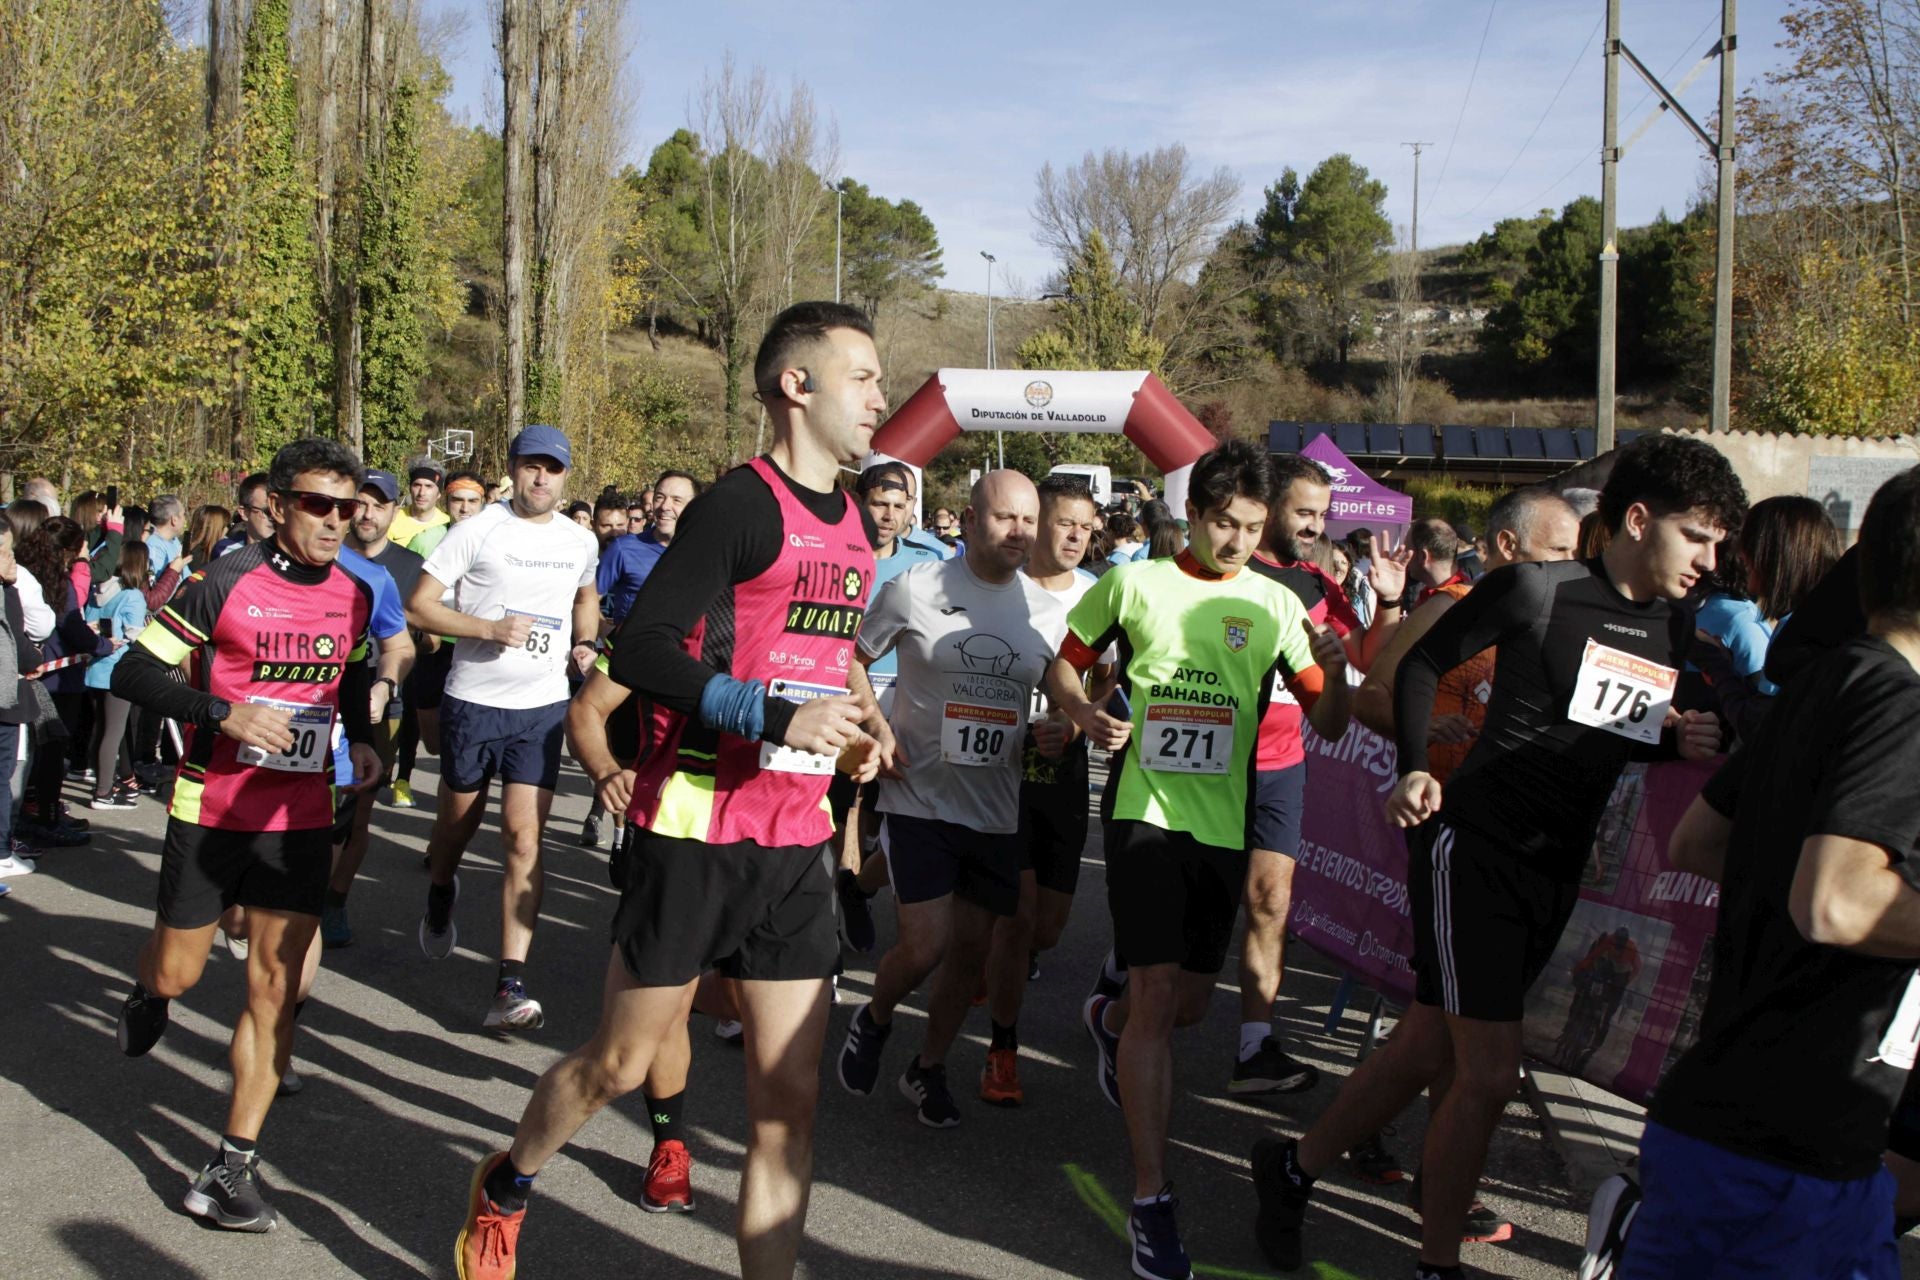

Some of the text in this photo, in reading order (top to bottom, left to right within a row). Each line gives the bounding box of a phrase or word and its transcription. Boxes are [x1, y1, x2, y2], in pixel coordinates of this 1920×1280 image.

[1172, 667, 1222, 686] AYTO.
[952, 683, 1016, 702] VALCORBA
[1150, 684, 1239, 709] BAHABON
[1594, 678, 1652, 723] 176
[1150, 707, 1230, 719] CARRERA POPULAR
[958, 726, 1004, 756] 180
[1159, 727, 1215, 760] 271
